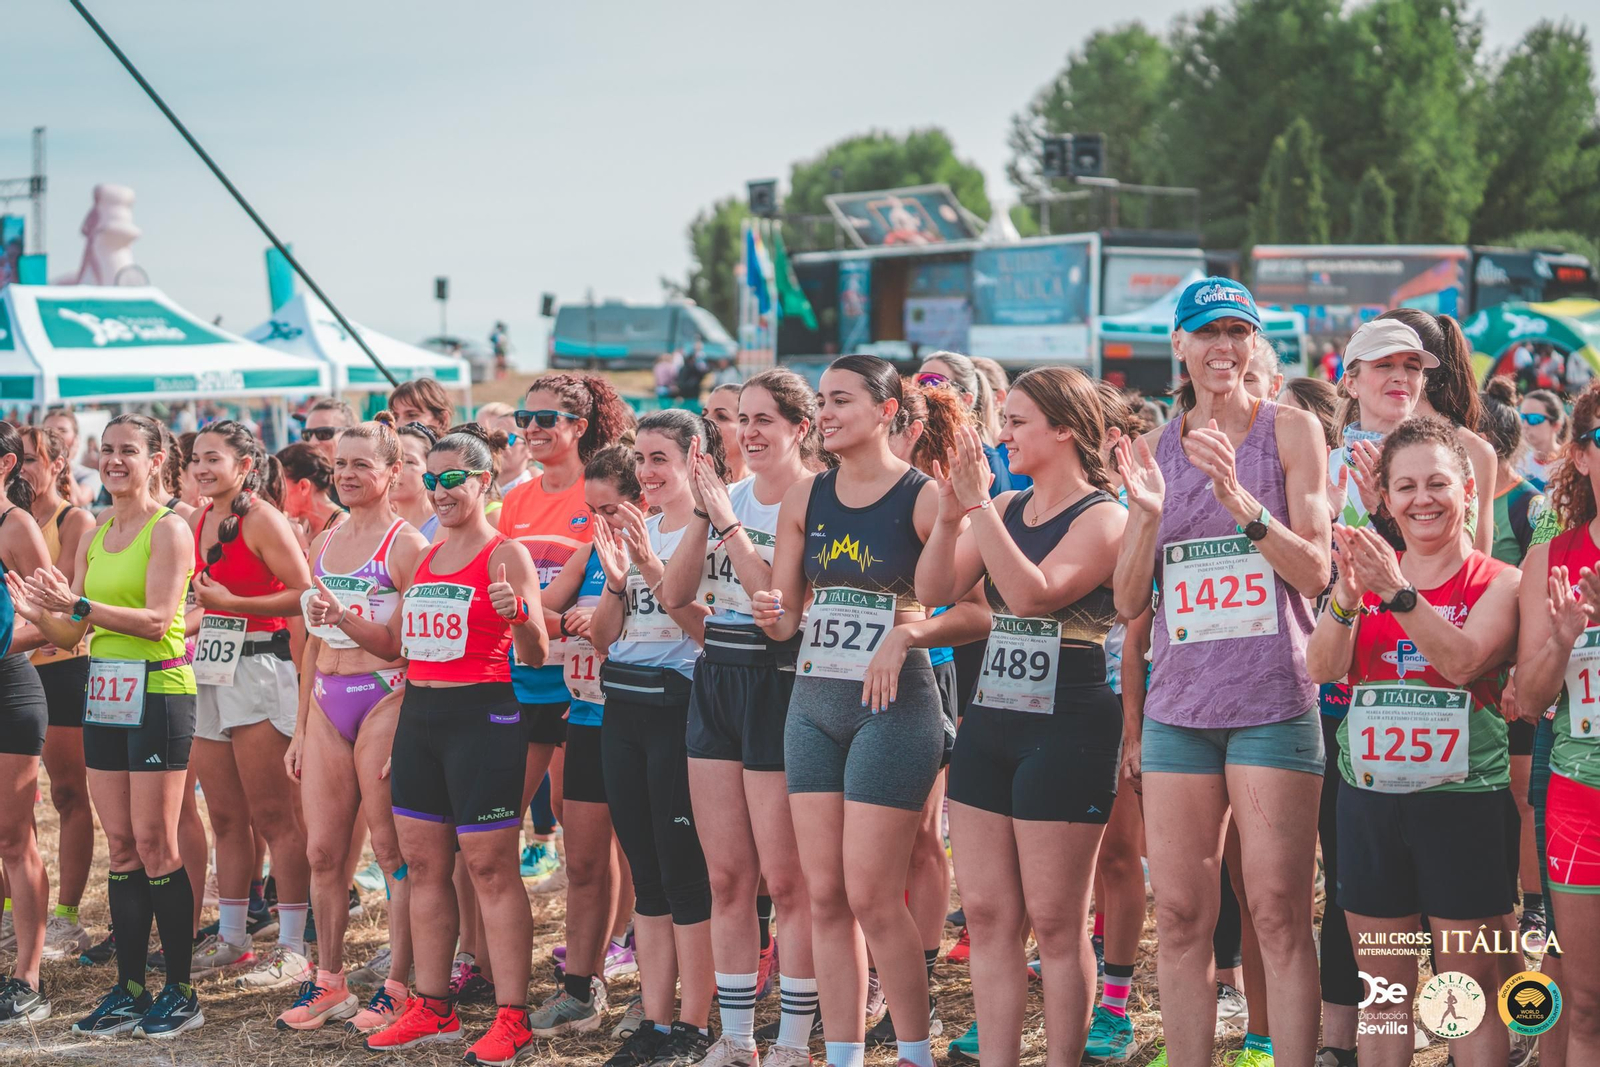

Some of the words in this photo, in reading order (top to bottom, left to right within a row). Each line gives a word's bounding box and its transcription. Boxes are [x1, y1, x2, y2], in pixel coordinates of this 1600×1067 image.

[1188, 541, 1240, 557] ITÁLICA
[828, 590, 868, 605] ITÁLICA
[1174, 573, 1267, 614] 1425
[405, 611, 463, 640] 1168
[810, 618, 886, 651] 1527
[195, 639, 236, 663] 1503
[983, 646, 1050, 682] 1489
[570, 654, 596, 680] 11
[89, 676, 138, 702] 1217
[1382, 690, 1437, 705] ITÁLICA
[1361, 726, 1460, 763] 1257
[478, 810, 514, 821] HANKER
